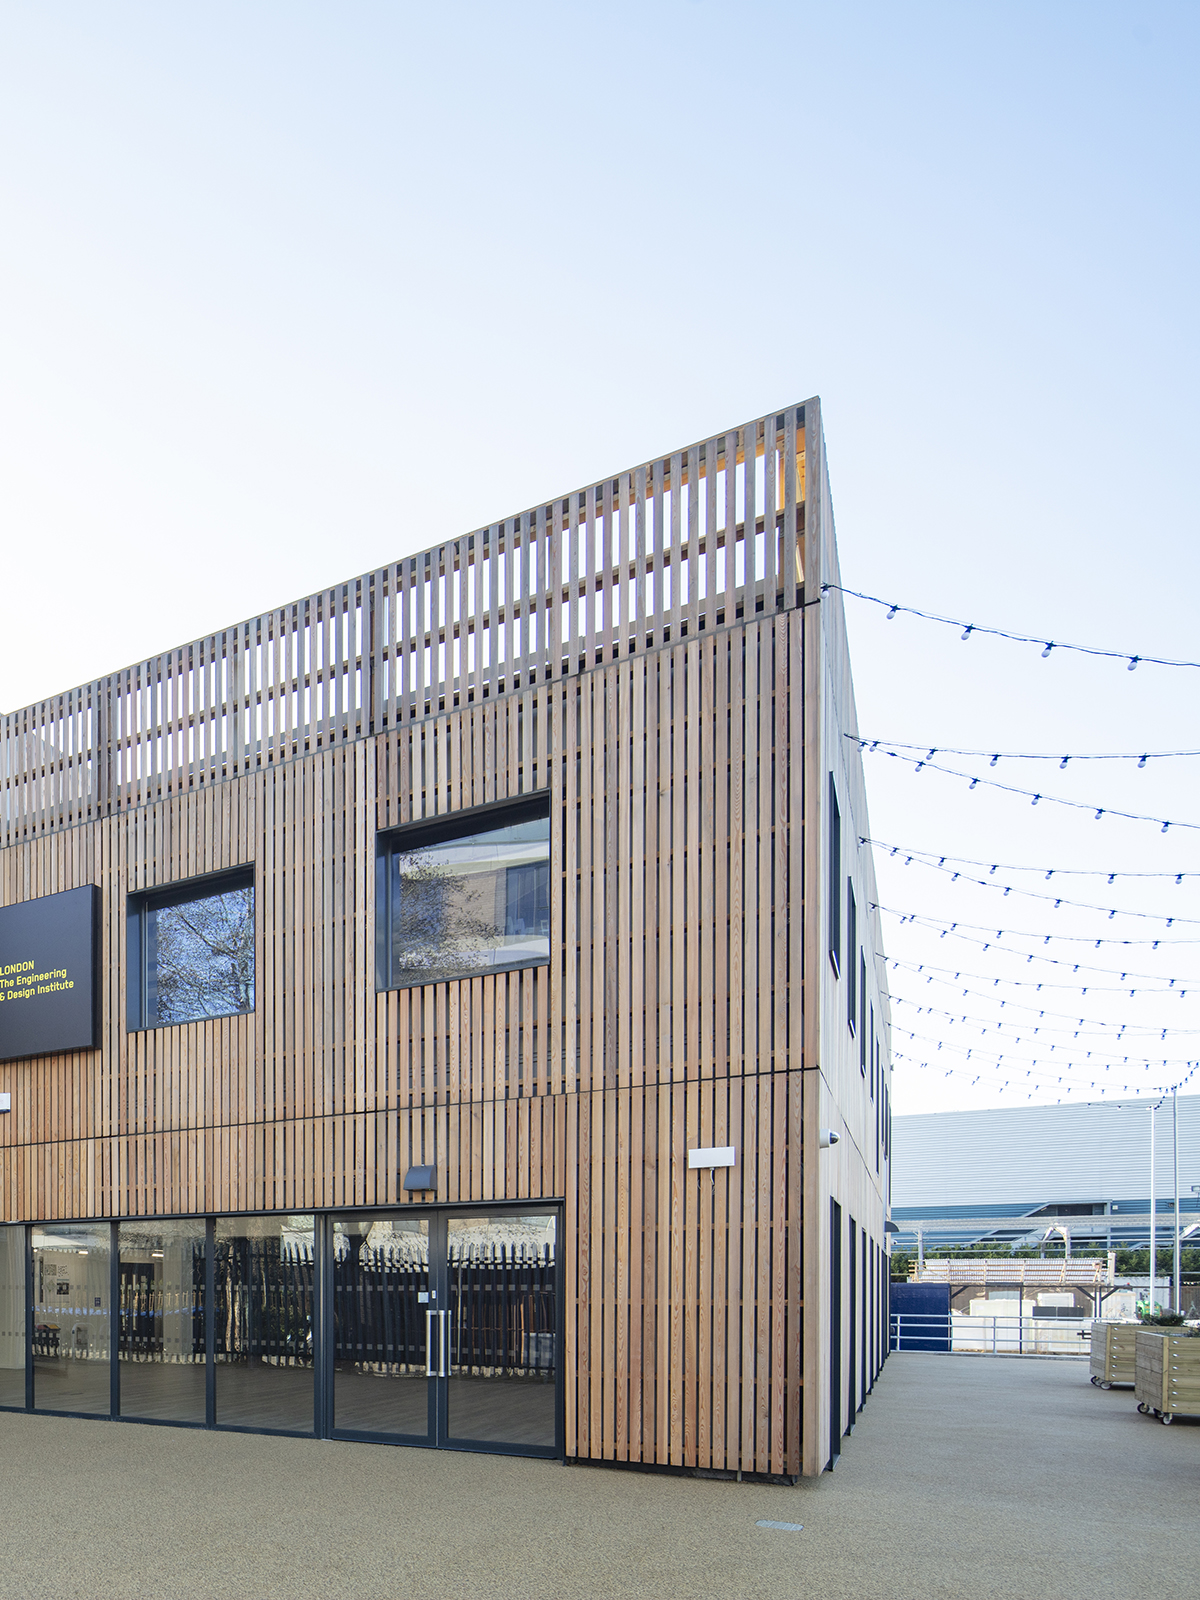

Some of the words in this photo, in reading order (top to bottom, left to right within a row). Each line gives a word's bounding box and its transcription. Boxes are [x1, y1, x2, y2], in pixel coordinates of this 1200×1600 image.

[0, 960, 35, 977] LONDON
[0, 979, 15, 989] The
[16, 968, 67, 986] Engineering
[0, 992, 6, 1002] &
[7, 988, 36, 1000] Design
[37, 980, 74, 995] Institute
